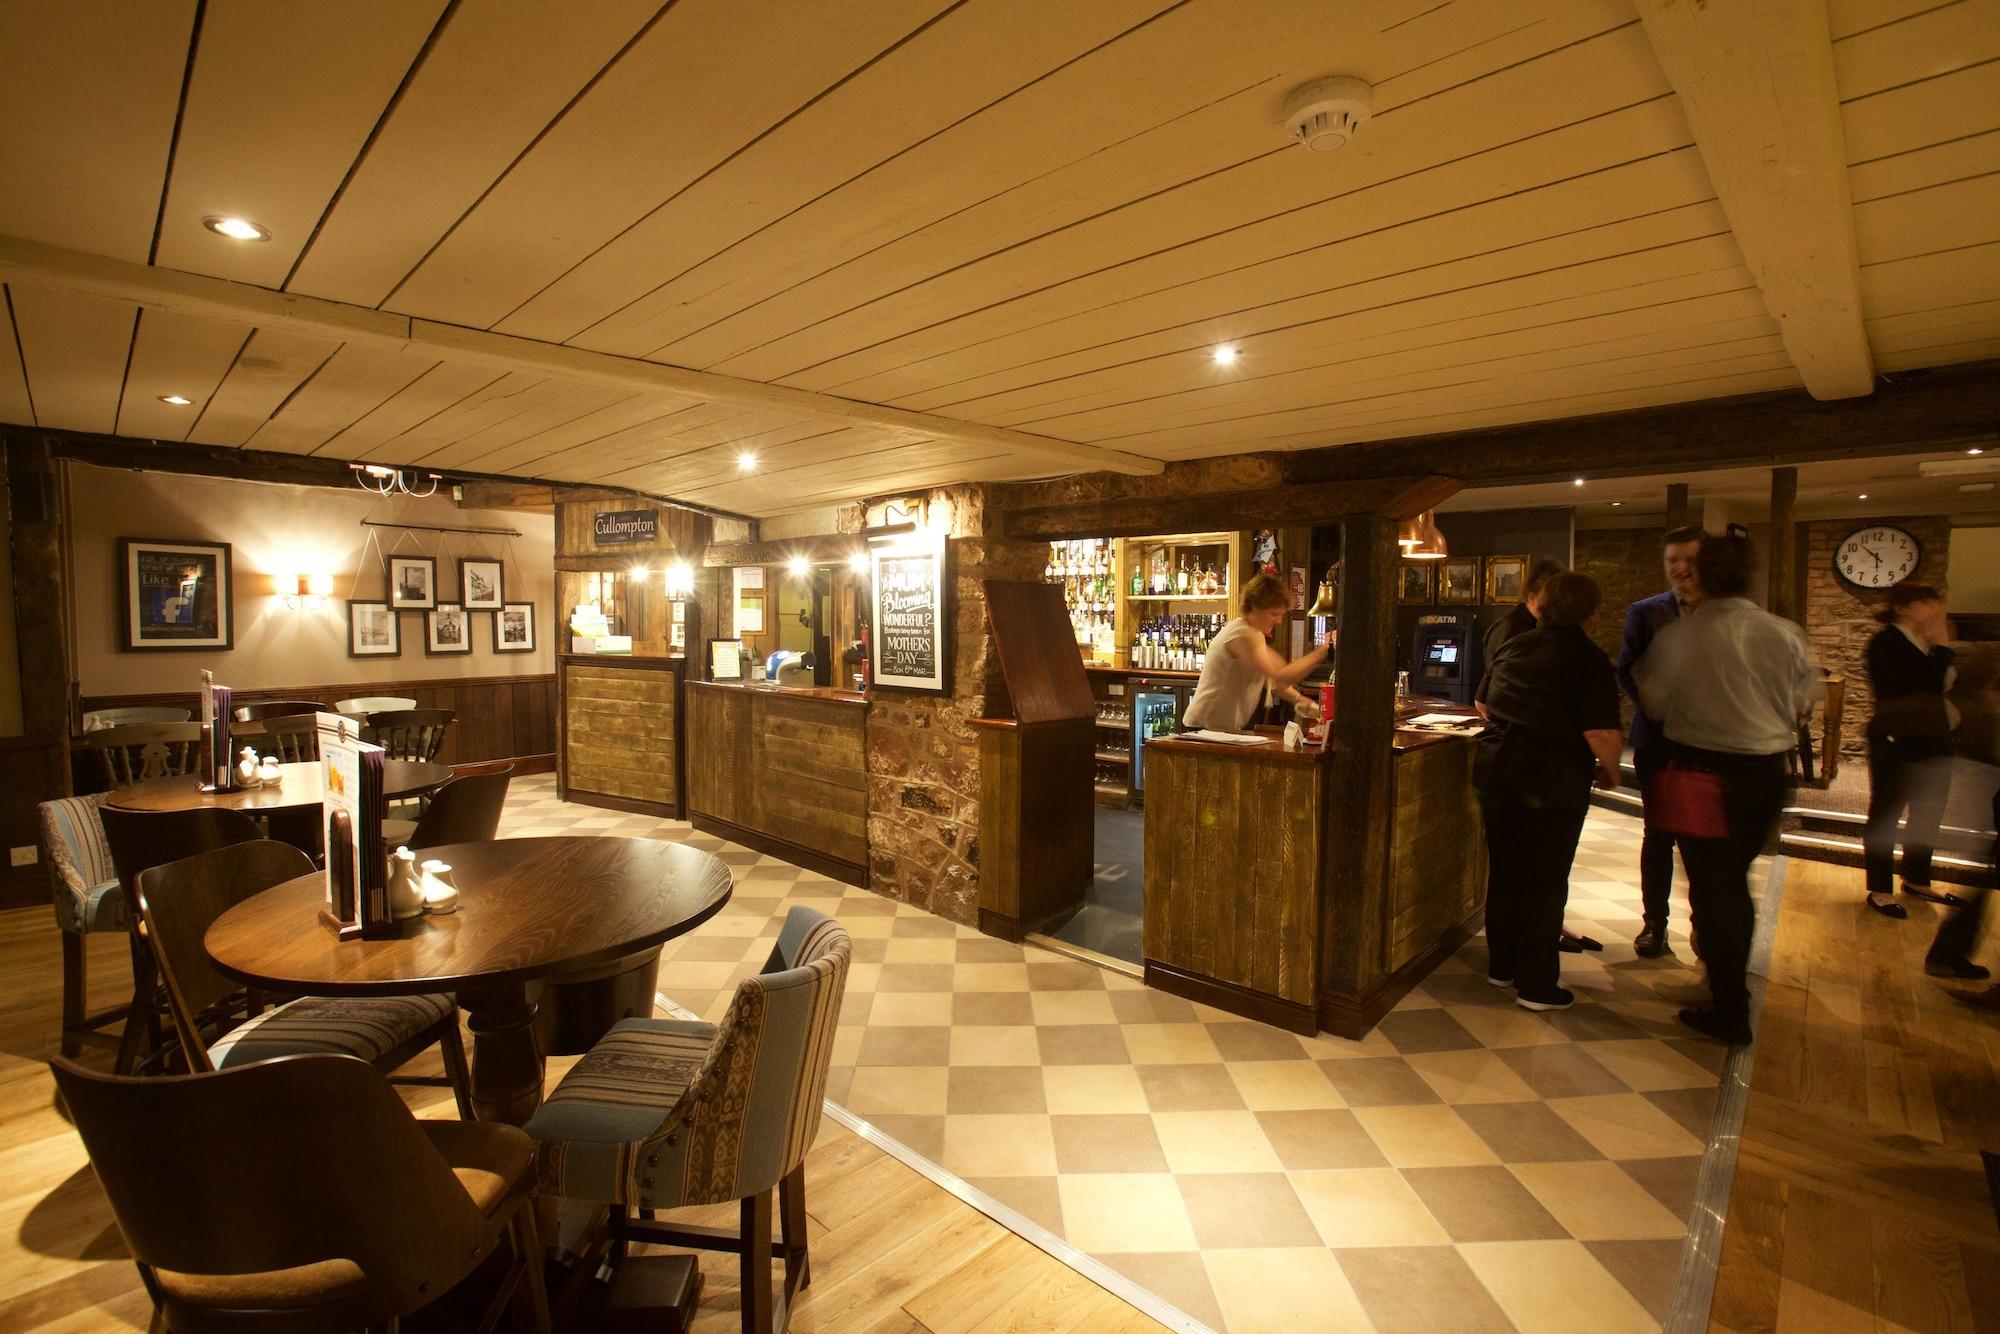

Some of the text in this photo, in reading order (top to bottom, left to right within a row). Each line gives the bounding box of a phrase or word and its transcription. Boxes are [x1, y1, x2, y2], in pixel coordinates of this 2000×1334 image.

[595, 515, 655, 539] Cullompton
[1861, 535, 1869, 544] 11
[1873, 532, 1884, 541] 12
[1891, 534, 1895, 543] 1
[1848, 543, 1858, 552] 10
[1900, 539, 1907, 549] 2
[1842, 554, 1848, 563] 9
[1906, 552, 1913, 562] 3
[1847, 565, 1853, 574] 8
[1900, 563, 1906, 573] 4
[142, 574, 169, 585] Like
[1858, 571, 1864, 581] 7
[1872, 574, 1878, 584] 6
[1888, 571, 1895, 581] 5
[881, 591, 935, 614] Blooming
[883, 613, 932, 627] WONDERFUL?
[1436, 615, 1457, 624] ATM
[887, 637, 931, 652] MOTHERS
[897, 652, 918, 665] DAY
